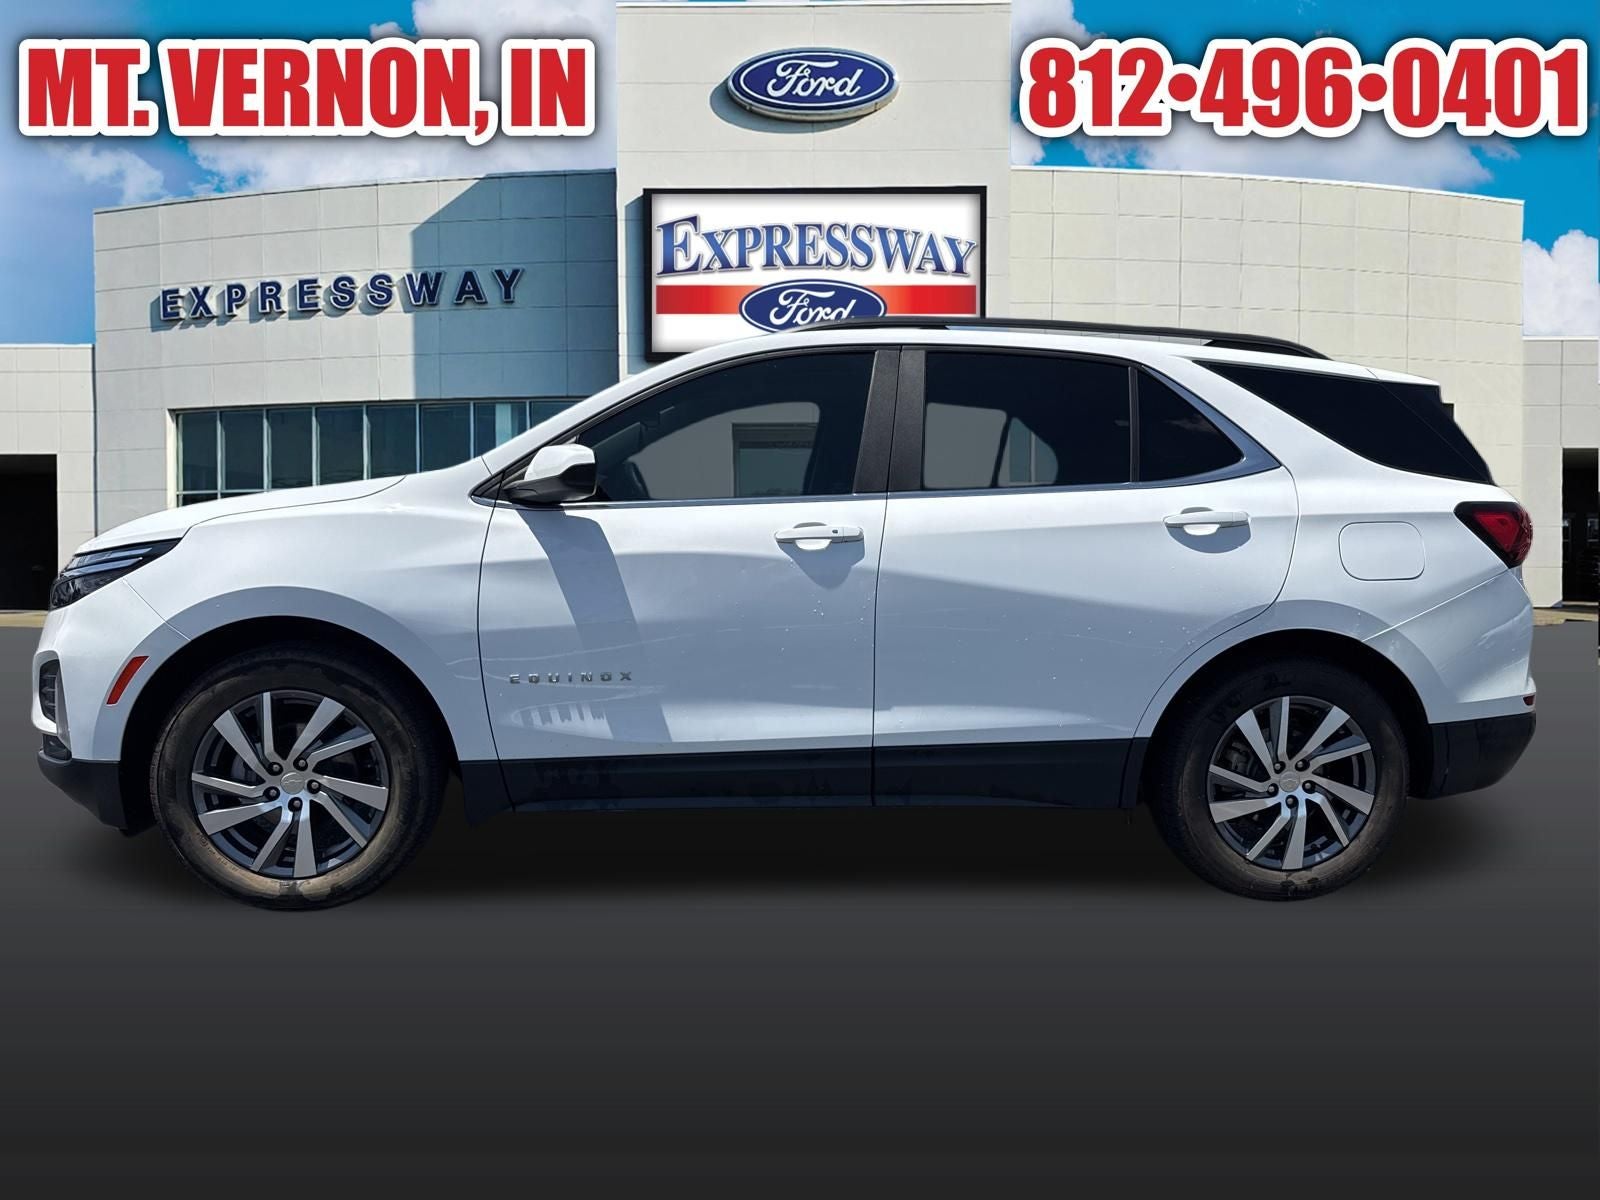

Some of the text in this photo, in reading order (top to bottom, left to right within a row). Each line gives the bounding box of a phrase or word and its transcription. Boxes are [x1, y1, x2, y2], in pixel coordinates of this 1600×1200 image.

[766, 59, 863, 98] Ford
[160, 267, 525, 322] EXPRESSWAY
[769, 288, 857, 324] Ford
[509, 671, 632, 684] EQUINOX
